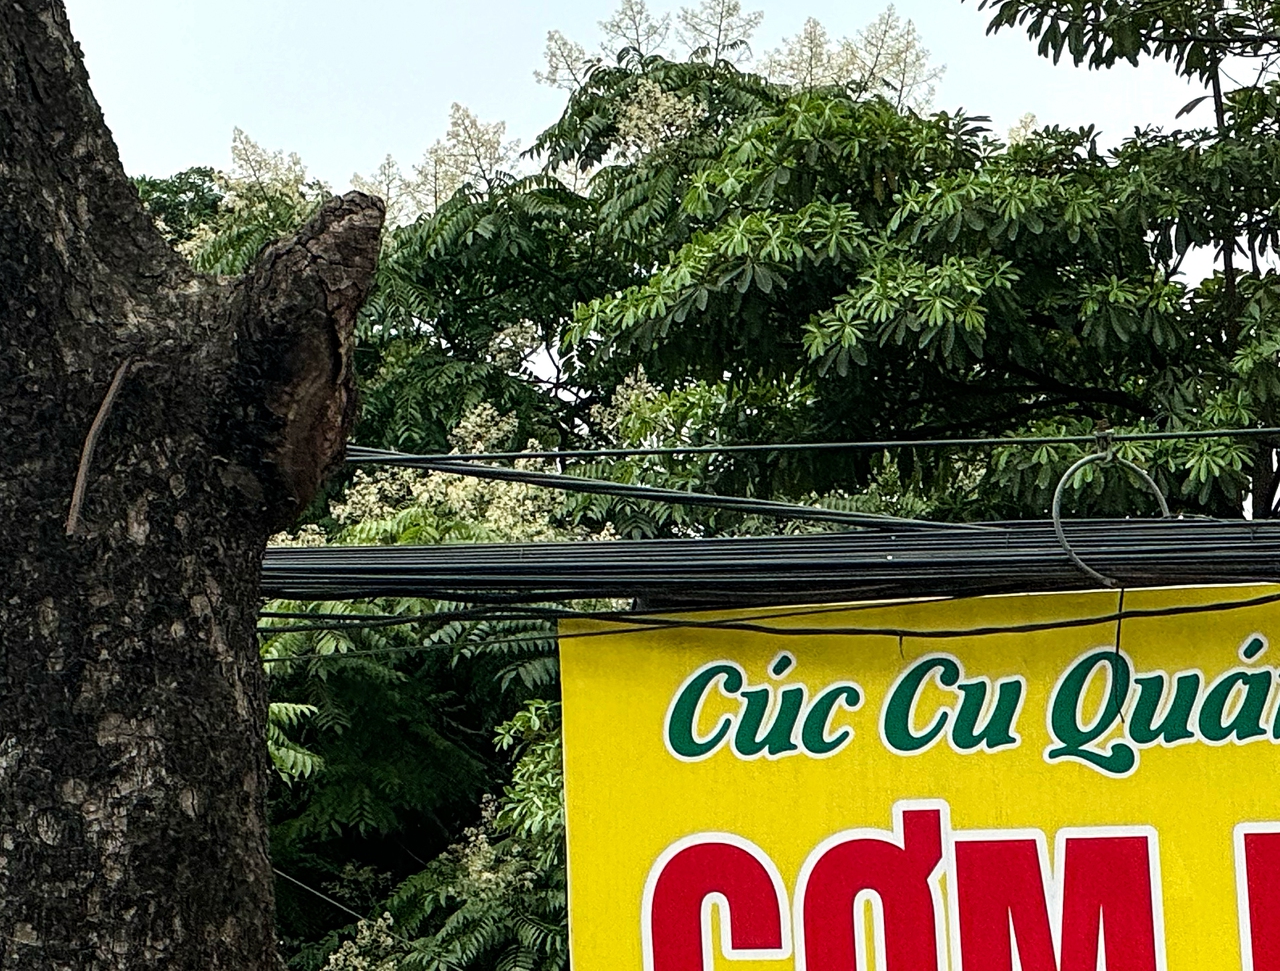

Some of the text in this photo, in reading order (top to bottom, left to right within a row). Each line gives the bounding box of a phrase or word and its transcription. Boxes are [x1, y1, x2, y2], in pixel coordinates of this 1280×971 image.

[665, 636, 1280, 775] Cúc Cu Quá
